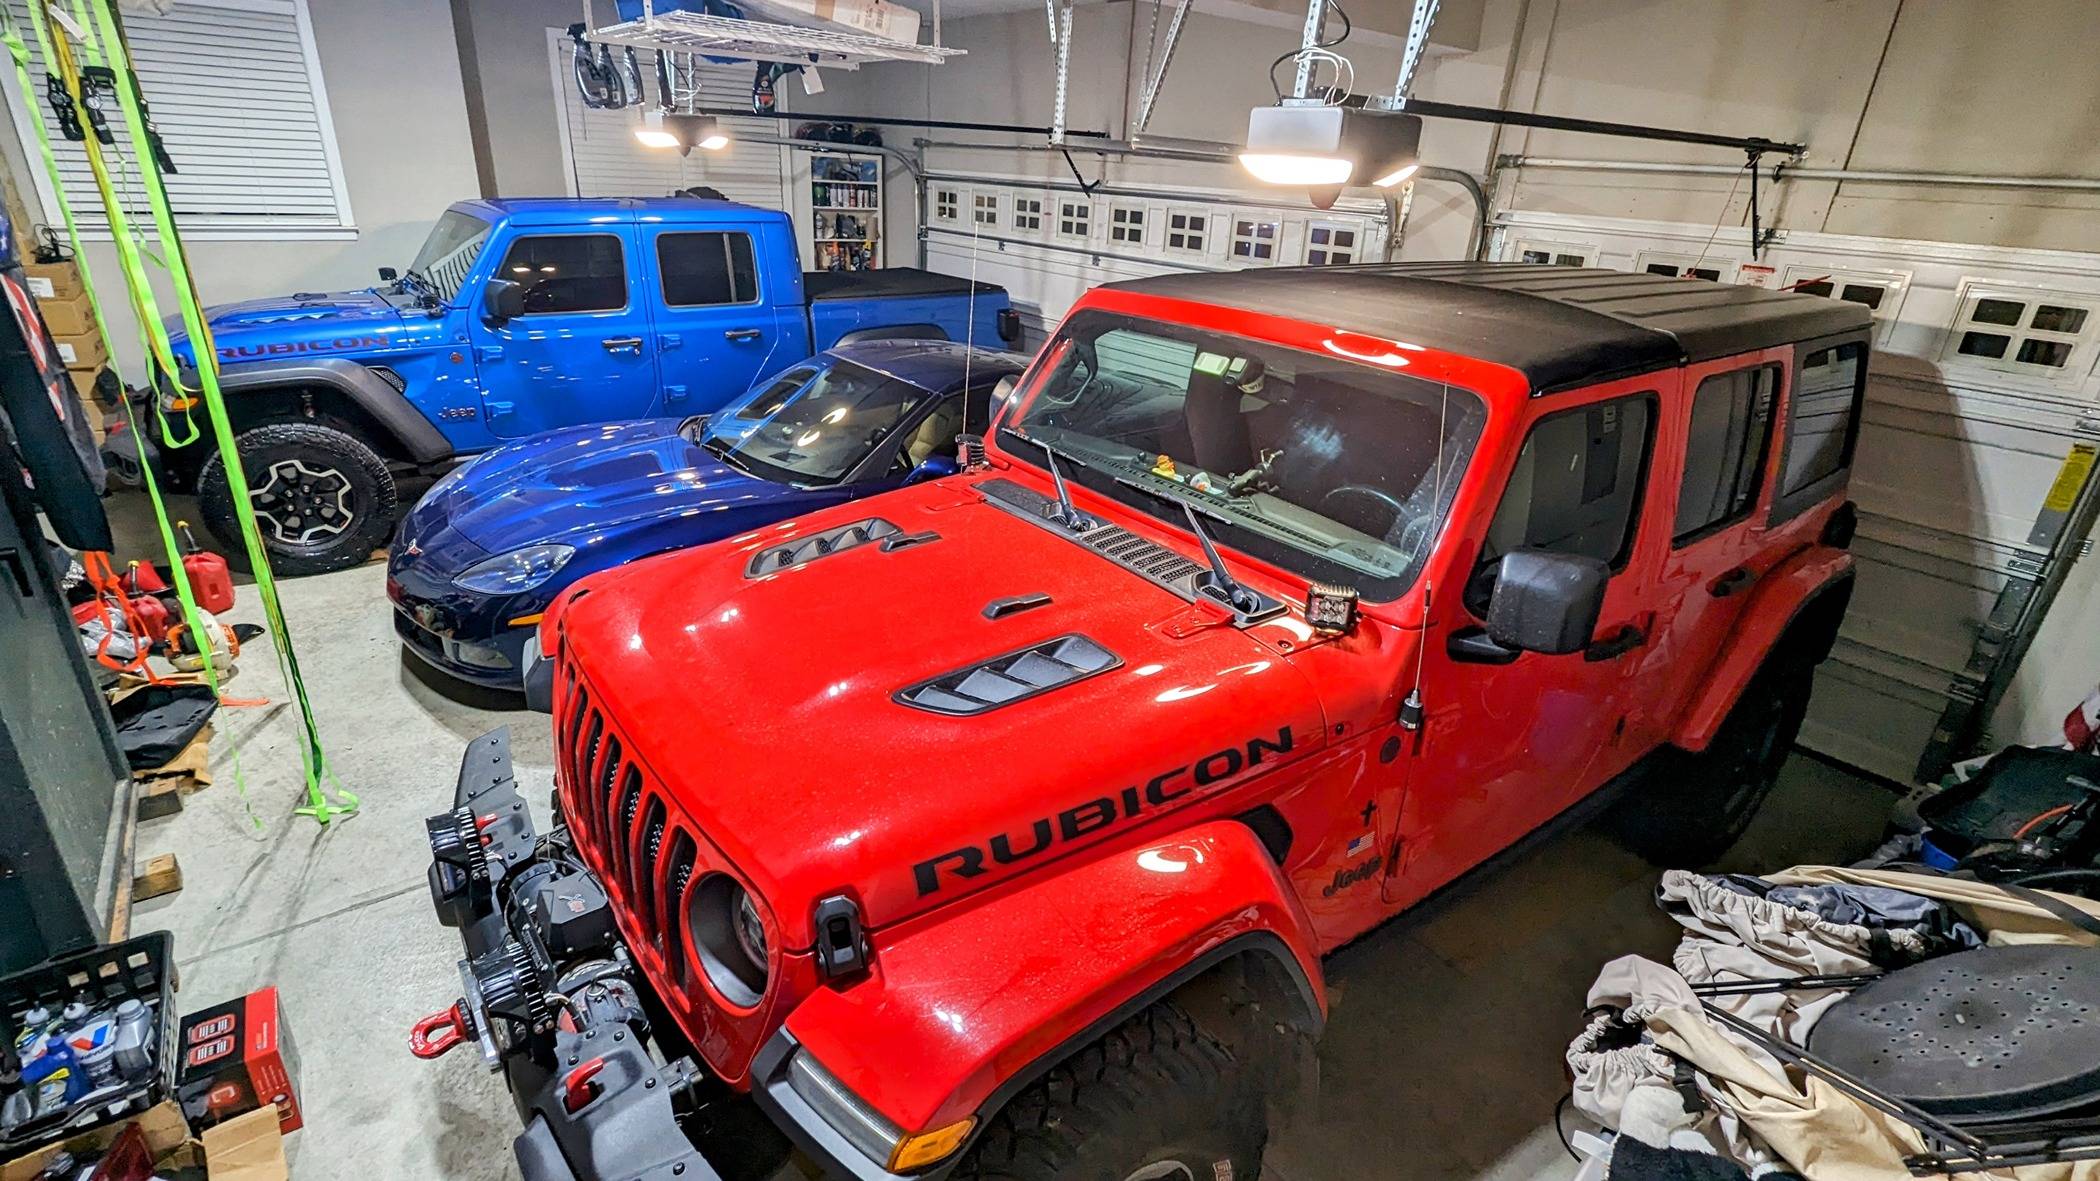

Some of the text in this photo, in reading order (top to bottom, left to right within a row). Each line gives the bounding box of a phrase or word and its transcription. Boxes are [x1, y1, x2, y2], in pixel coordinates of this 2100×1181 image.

[215, 335, 390, 359] RUBICON
[912, 725, 1294, 897] RUBICON
[1322, 855, 1383, 897] Jeep
